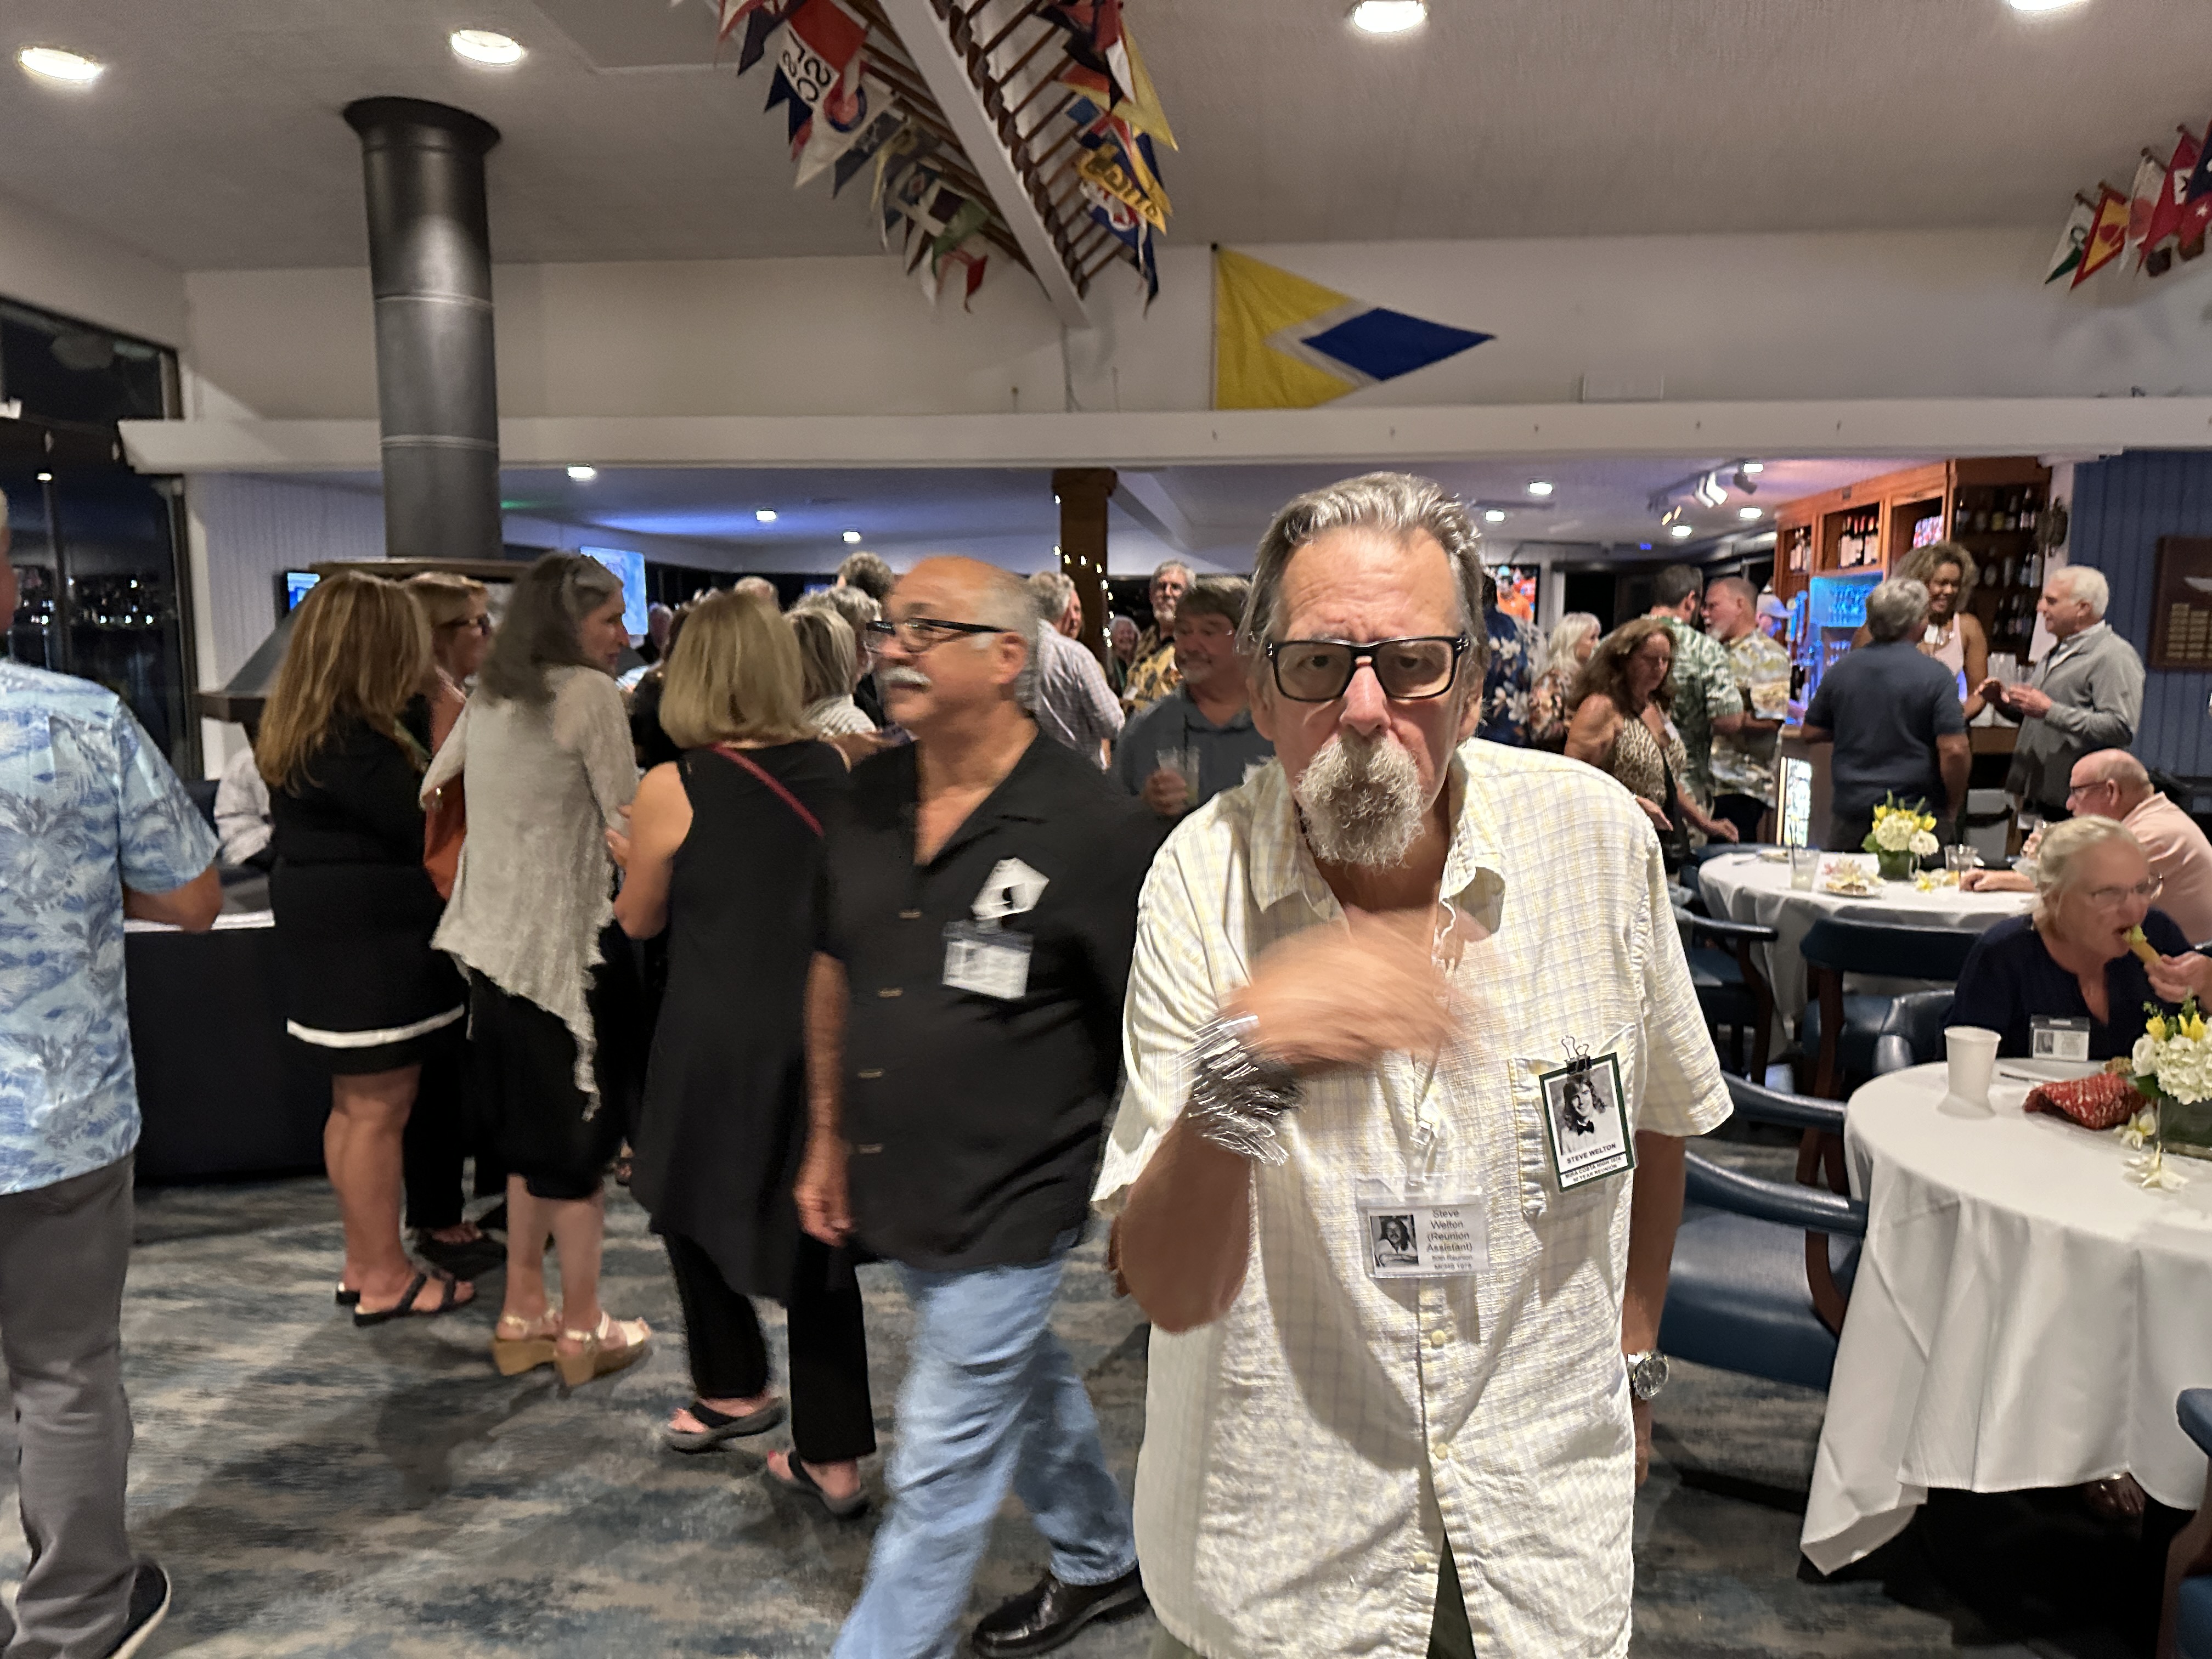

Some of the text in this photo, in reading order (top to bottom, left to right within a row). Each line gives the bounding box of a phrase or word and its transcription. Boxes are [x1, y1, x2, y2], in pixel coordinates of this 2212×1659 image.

[1567, 1143, 1616, 1164] STEVE WELTON
[1579, 1171, 1594, 1180] YEAR
[1594, 1164, 1617, 1175] REUNION
[1432, 1209, 1459, 1218] Steve
[1430, 1220, 1464, 1229] Welton
[1427, 1232, 1470, 1242] (Reunion
[1427, 1242, 1473, 1252] Assistant)
